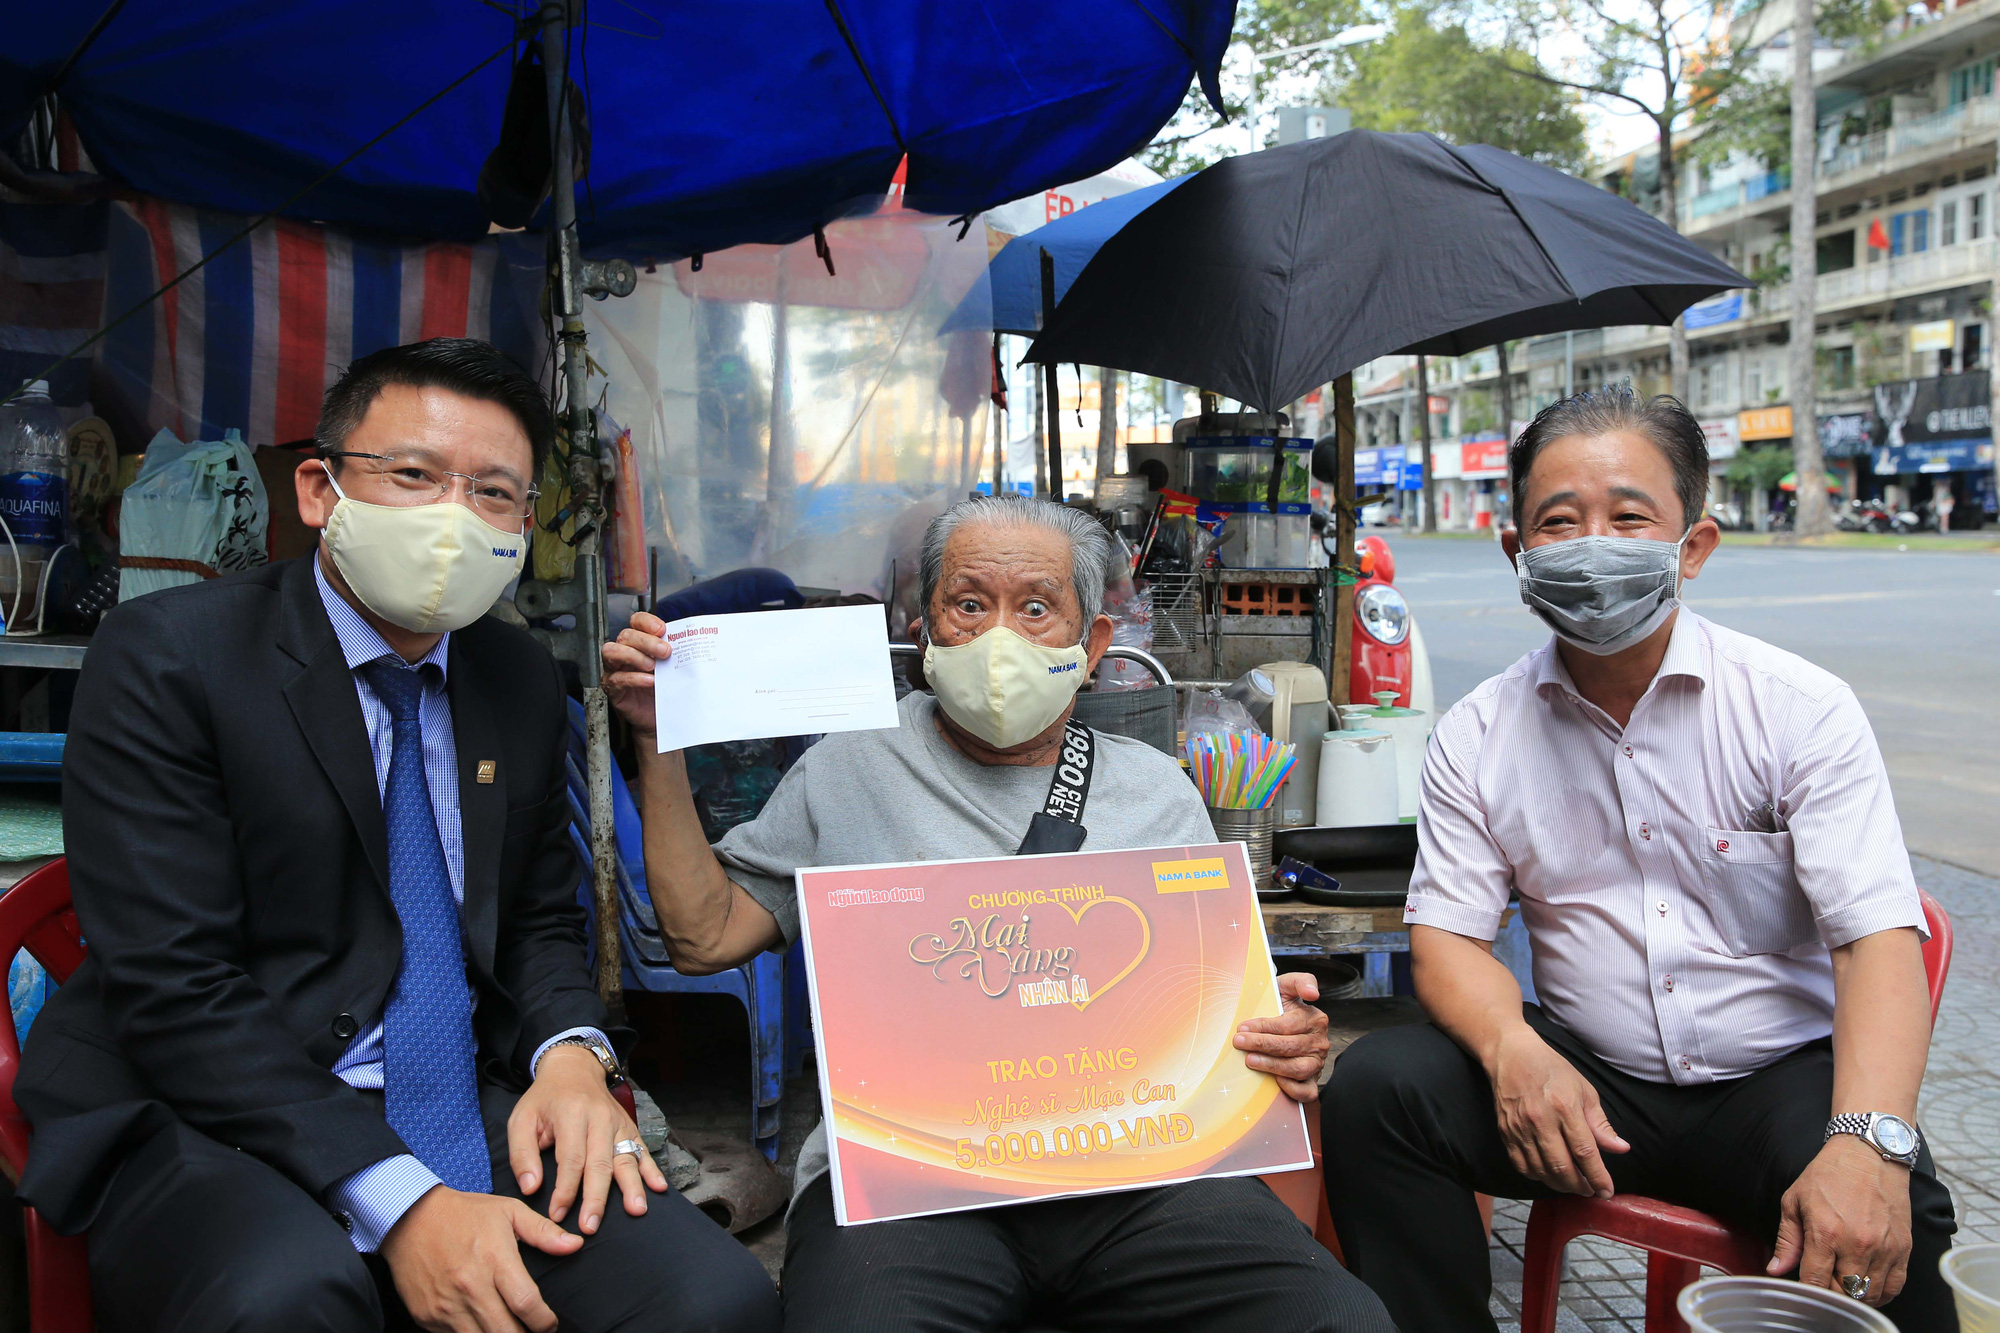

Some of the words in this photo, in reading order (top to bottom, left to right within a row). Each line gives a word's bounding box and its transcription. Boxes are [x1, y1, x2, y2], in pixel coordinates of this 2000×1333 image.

[0, 498, 62, 518] AQUAFINA
[1058, 724, 1090, 787] 1980
[1062, 789, 1082, 823] CIT
[1157, 872, 1183, 881] NAM
[1185, 872, 1192, 880] A
[1193, 869, 1223, 879] BANK
[868, 888, 889, 904] lao
[968, 889, 1047, 909] CHƯƠNG
[1050, 885, 1105, 904] TRÌNH
[1018, 977, 1069, 1008] NHÂN
[1070, 974, 1090, 1003] ÁI
[986, 1055, 1058, 1084] TRAO
[1064, 1046, 1138, 1079] TẶNG
[963, 1094, 1035, 1132] Nghệ
[1040, 1092, 1061, 1115] sĩ
[1066, 1084, 1125, 1112] Mạc
[1132, 1078, 1177, 1105] Can
[955, 1121, 1114, 1170] 5.000.000
[1117, 1112, 1195, 1149] VNĐ
